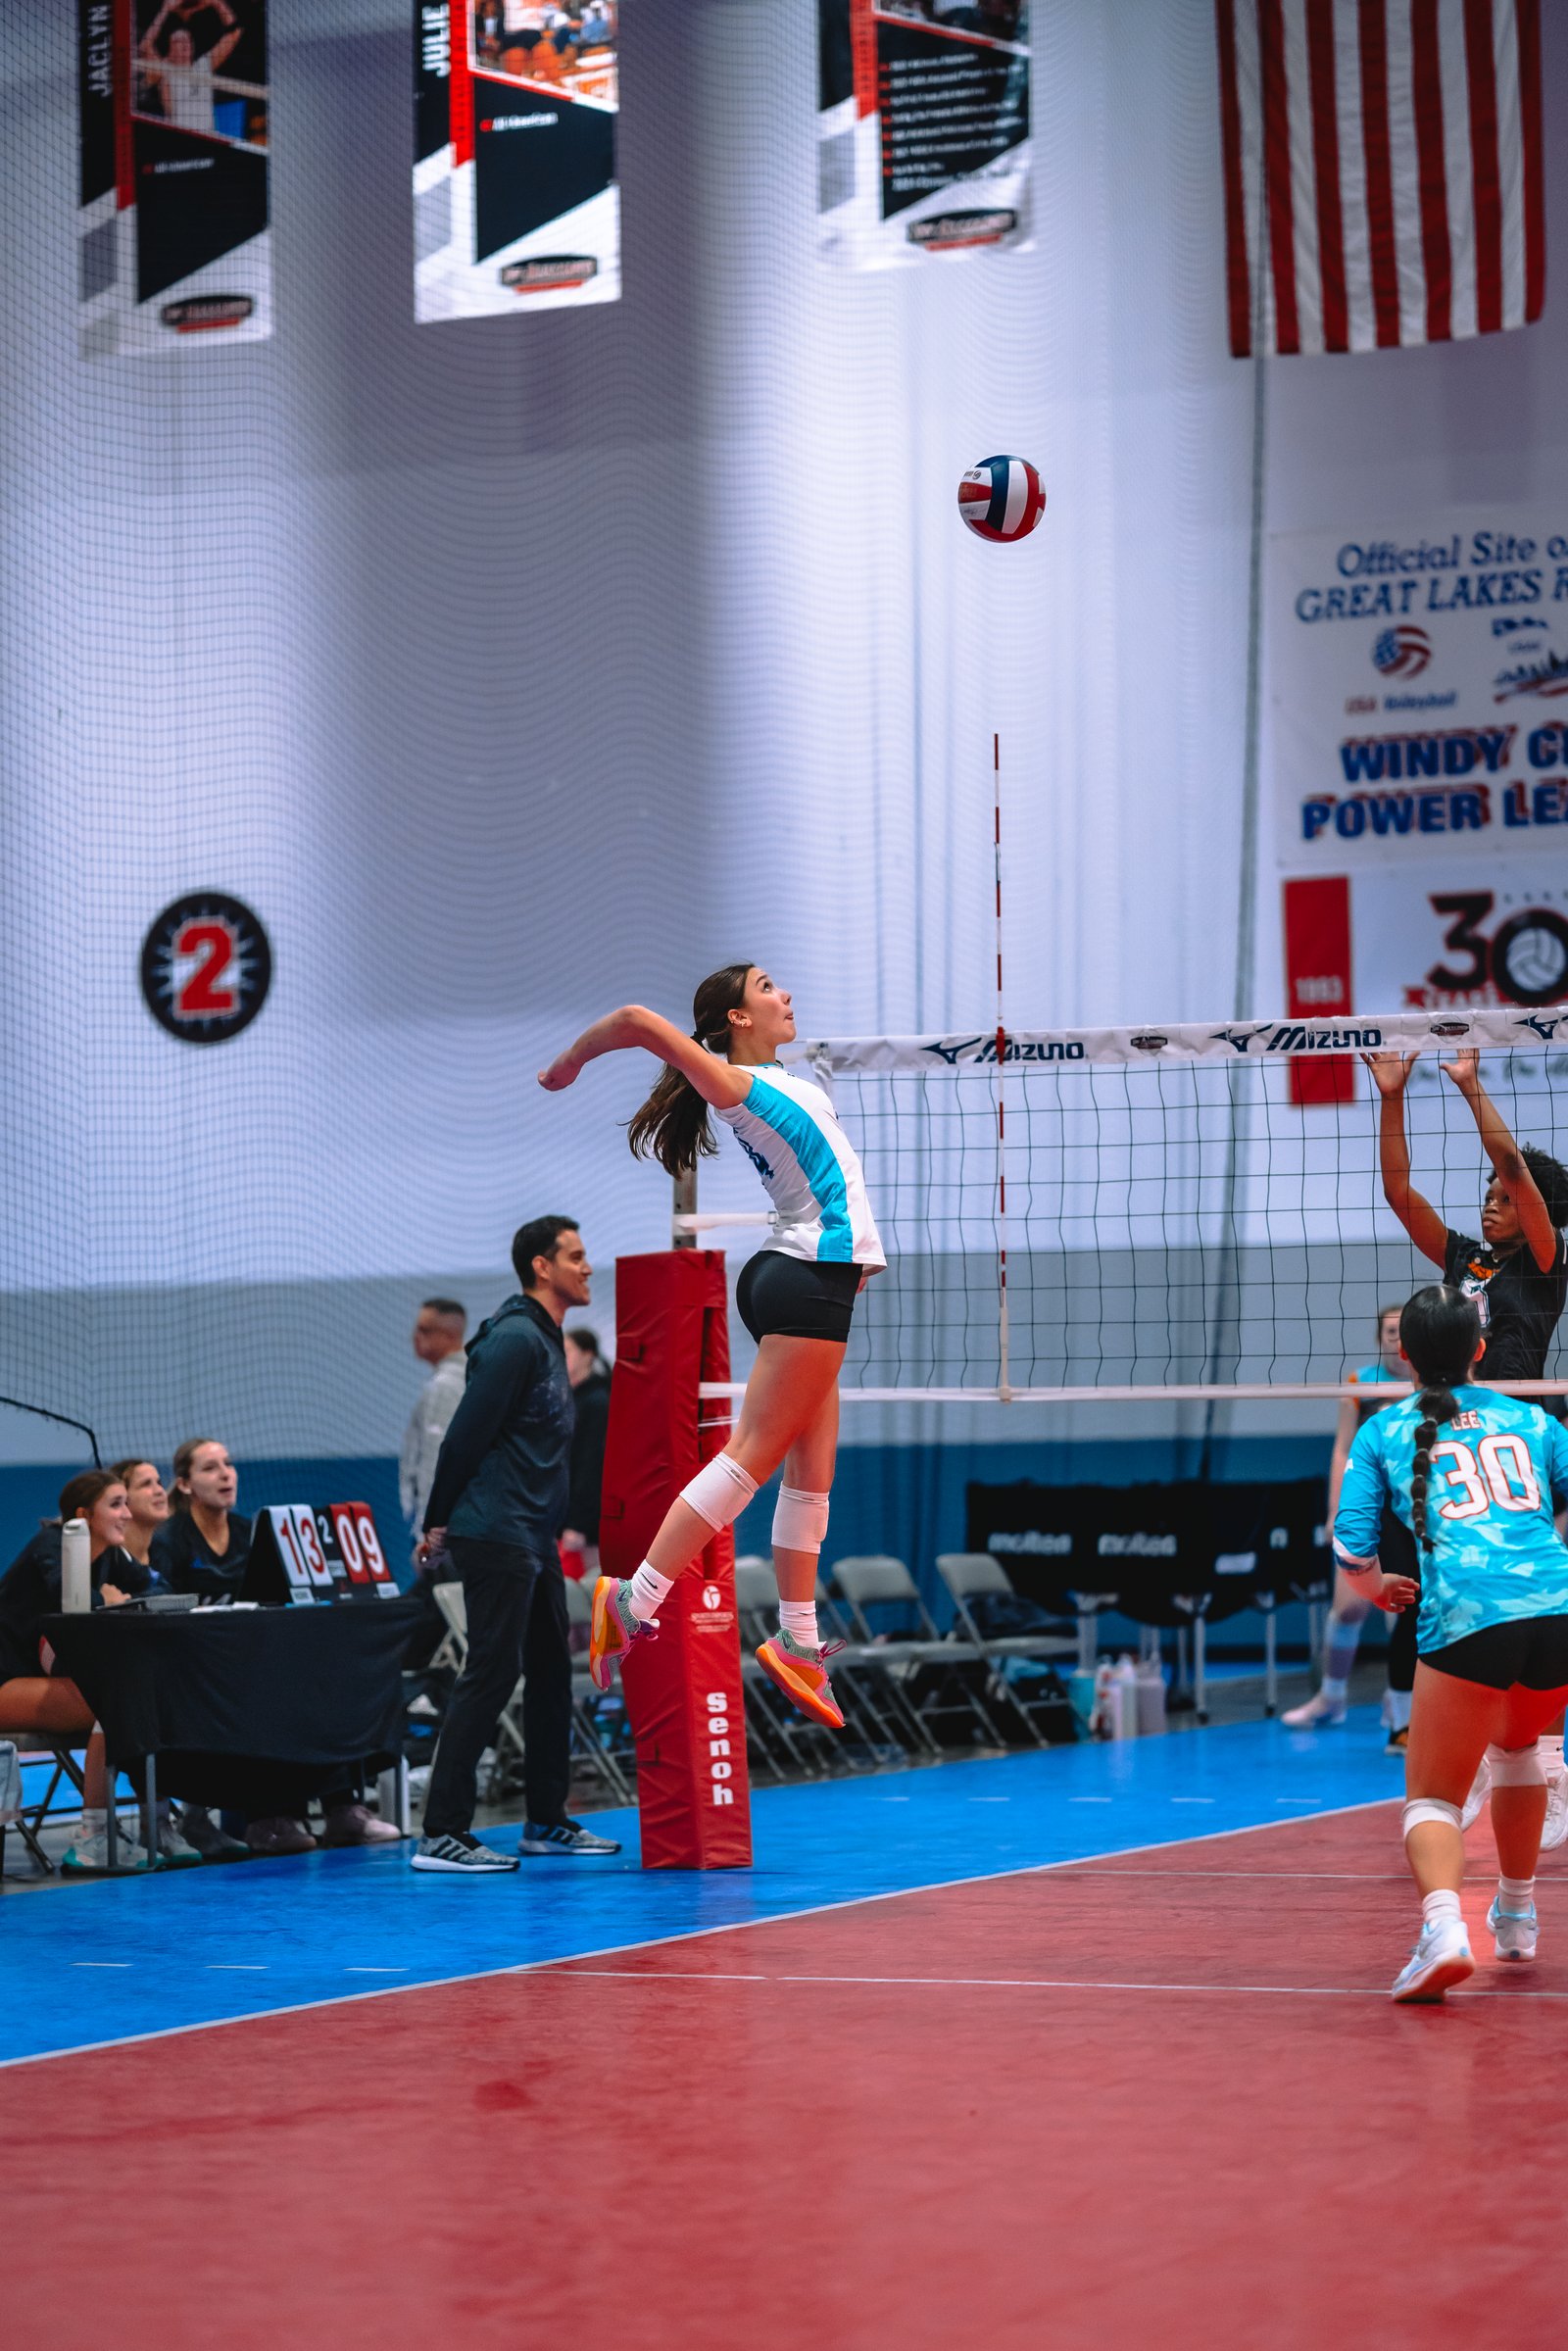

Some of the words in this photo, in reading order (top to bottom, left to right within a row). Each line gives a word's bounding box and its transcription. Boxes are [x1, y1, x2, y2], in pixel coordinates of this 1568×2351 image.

[1337, 535, 1461, 578] Official
[1471, 531, 1537, 565] Site
[1295, 579, 1418, 623] GREAT
[1426, 568, 1543, 612] LAKES
[1340, 726, 1516, 782] WINDY
[1301, 784, 1491, 840] POWER
[1503, 780, 1568, 828] LE
[176, 921, 236, 1015] 2
[1430, 1434, 1542, 1519] 30
[280, 1517, 325, 1575] 13
[318, 1515, 333, 1544] 2
[336, 1514, 385, 1575] 09
[706, 1692, 735, 1806] senoh
